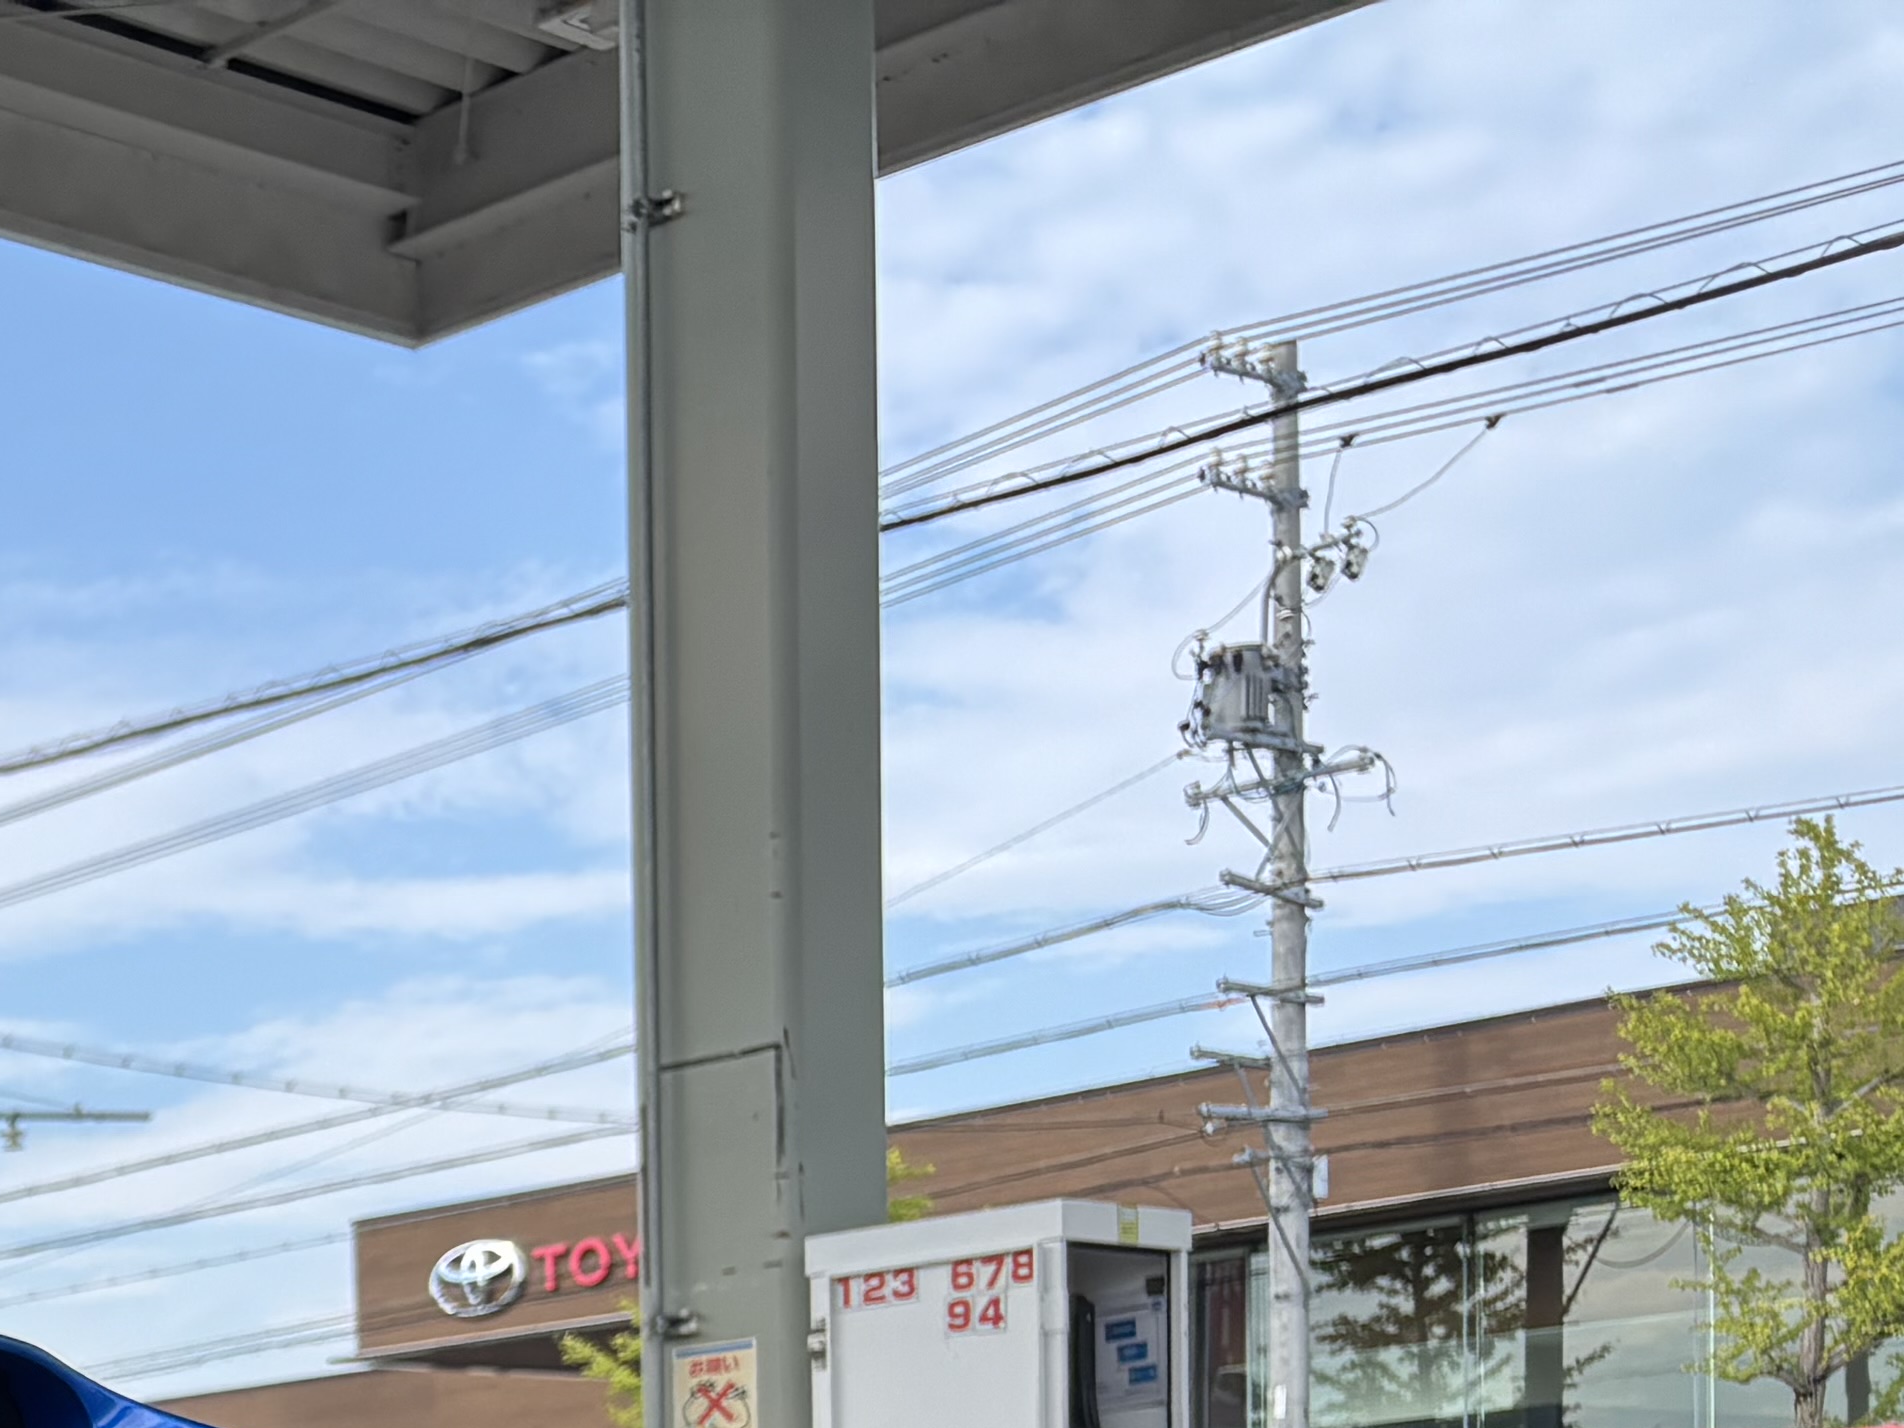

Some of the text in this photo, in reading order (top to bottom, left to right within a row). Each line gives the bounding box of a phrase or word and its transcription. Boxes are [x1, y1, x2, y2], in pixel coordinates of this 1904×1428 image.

[837, 1247, 1034, 1309] 123 678
[947, 1295, 1005, 1333] 94
